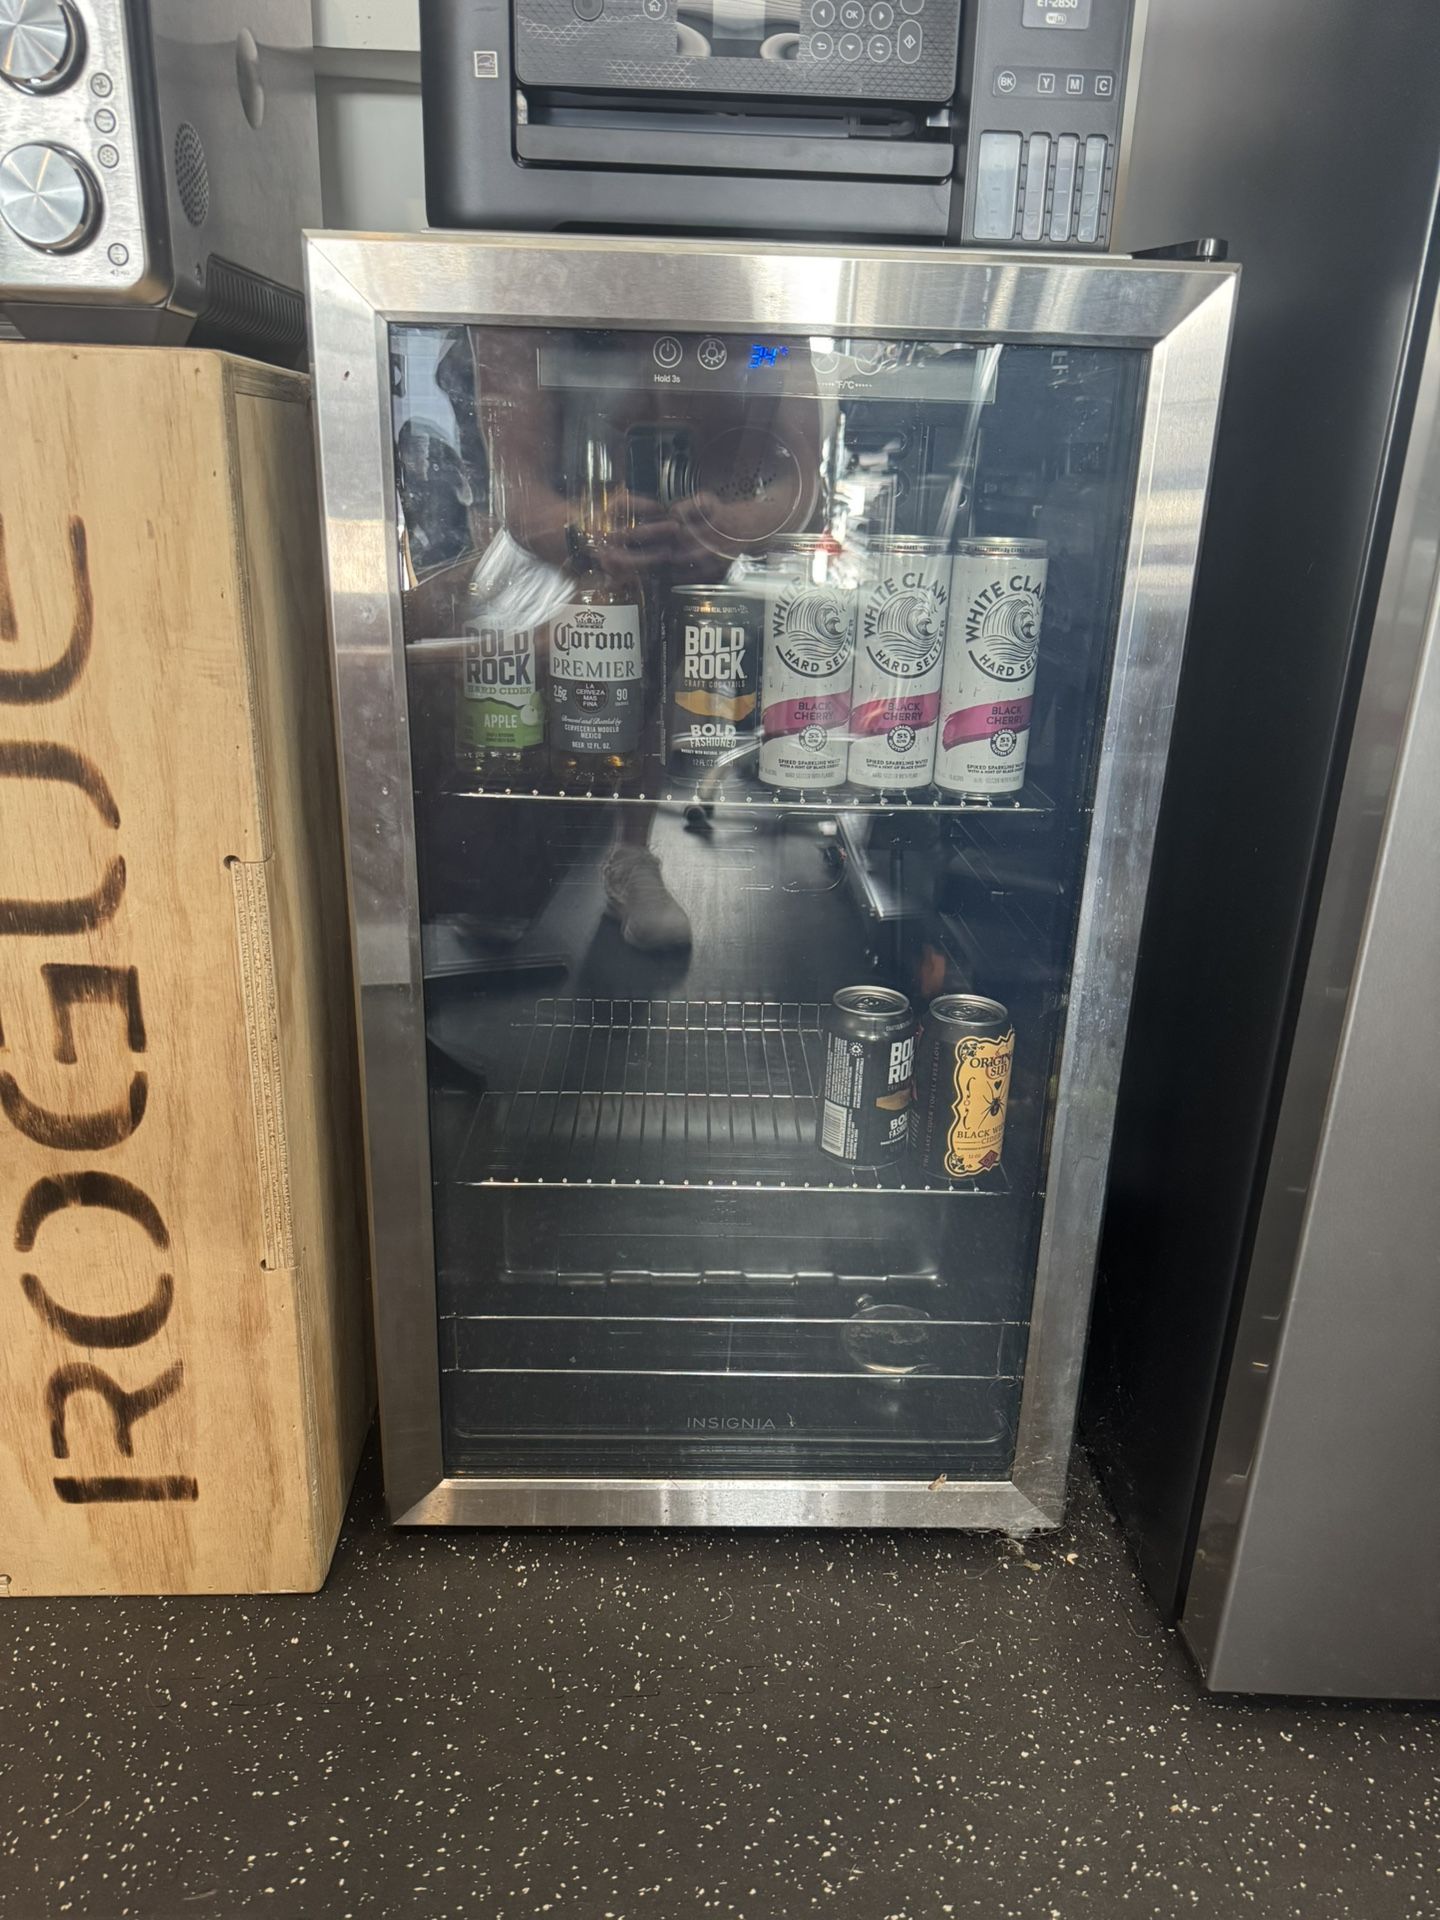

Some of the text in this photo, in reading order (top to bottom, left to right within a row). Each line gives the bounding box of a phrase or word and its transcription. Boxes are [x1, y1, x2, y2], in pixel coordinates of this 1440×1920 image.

[846, 10, 858, 19] OK
[1000, 77, 1108, 91] BK Y M C
[654, 374, 681, 383] Hold 3s
[864, 577, 898, 638] WHITE
[902, 572, 947, 605] CLAW
[965, 581, 1005, 643] WHITE
[465, 626, 529, 658] BOLD
[553, 622, 635, 656] Corona
[685, 625, 745, 655] BOLD
[553, 656, 636, 678] PREMIER
[684, 650, 748, 680] ROCK
[784, 649, 819, 672] HARD
[875, 649, 909, 673] HARD
[979, 654, 1014, 676] HARD
[466, 653, 532, 685] ROCK
[467, 685, 532, 695] HARD CIDER
[684, 680, 706, 688] CRAFT
[616, 688, 629, 701] 90
[798, 702, 832, 711] BLACK
[888, 702, 921, 711] BLACK
[992, 706, 1023, 715] BLACK
[484, 713, 519, 729] APPLE
[793, 711, 834, 720] CHERRY
[882, 711, 923, 721] CHERRY
[986, 715, 1024, 725] CHERRY
[690, 723, 736, 737] BOLD
[690, 737, 737, 748] FASHIONED
[890, 1036, 914, 1067] BOL
[970, 1053, 1012, 1068] ORIGIN
[888, 1055, 914, 1084] ROC
[890, 1112, 908, 1130] BOL
[957, 1129, 990, 1138] BLACK
[687, 1417, 776, 1429] INSIGNIA
